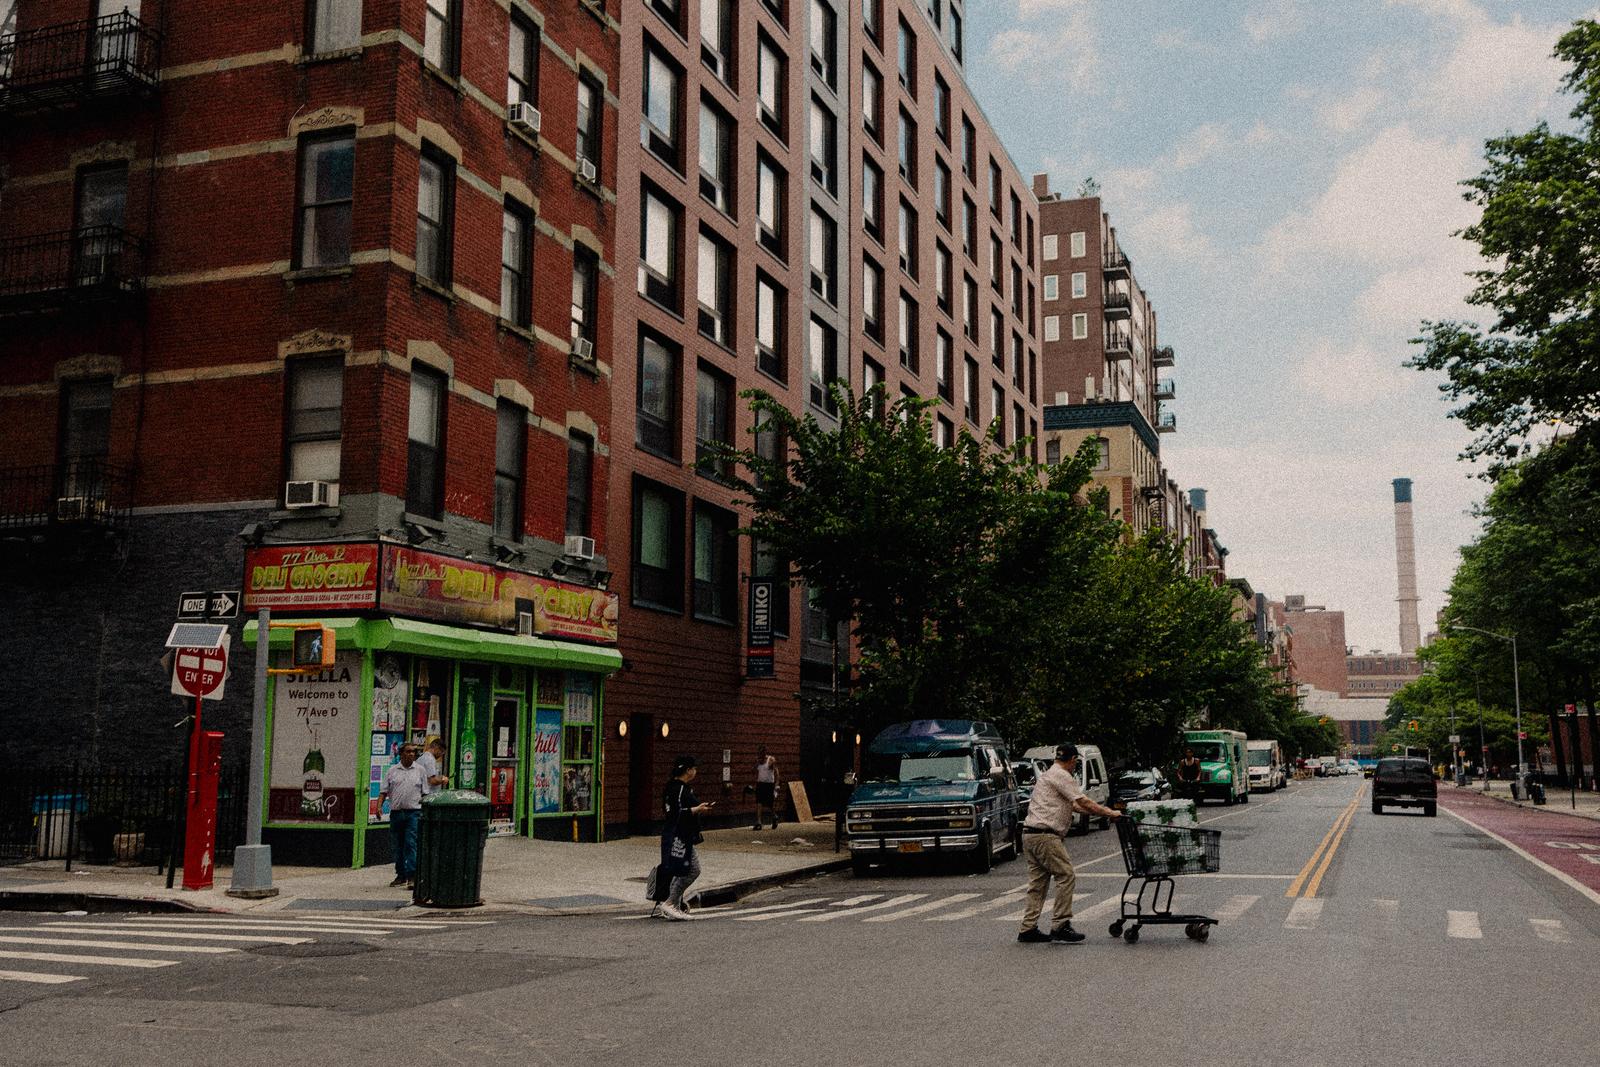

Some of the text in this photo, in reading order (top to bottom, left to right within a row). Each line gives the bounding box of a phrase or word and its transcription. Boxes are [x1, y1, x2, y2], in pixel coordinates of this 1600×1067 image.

[282, 553, 301, 565] 77
[251, 562, 371, 590] DELI GROCERY
[442, 565, 495, 603] DELI
[187, 599, 229, 610] ONE WAY
[754, 585, 769, 626] NIKO
[185, 671, 214, 685] ENER
[289, 690, 349, 699] Welcome to
[296, 707, 338, 717] 77 Ave D
[535, 731, 561, 753] hill
